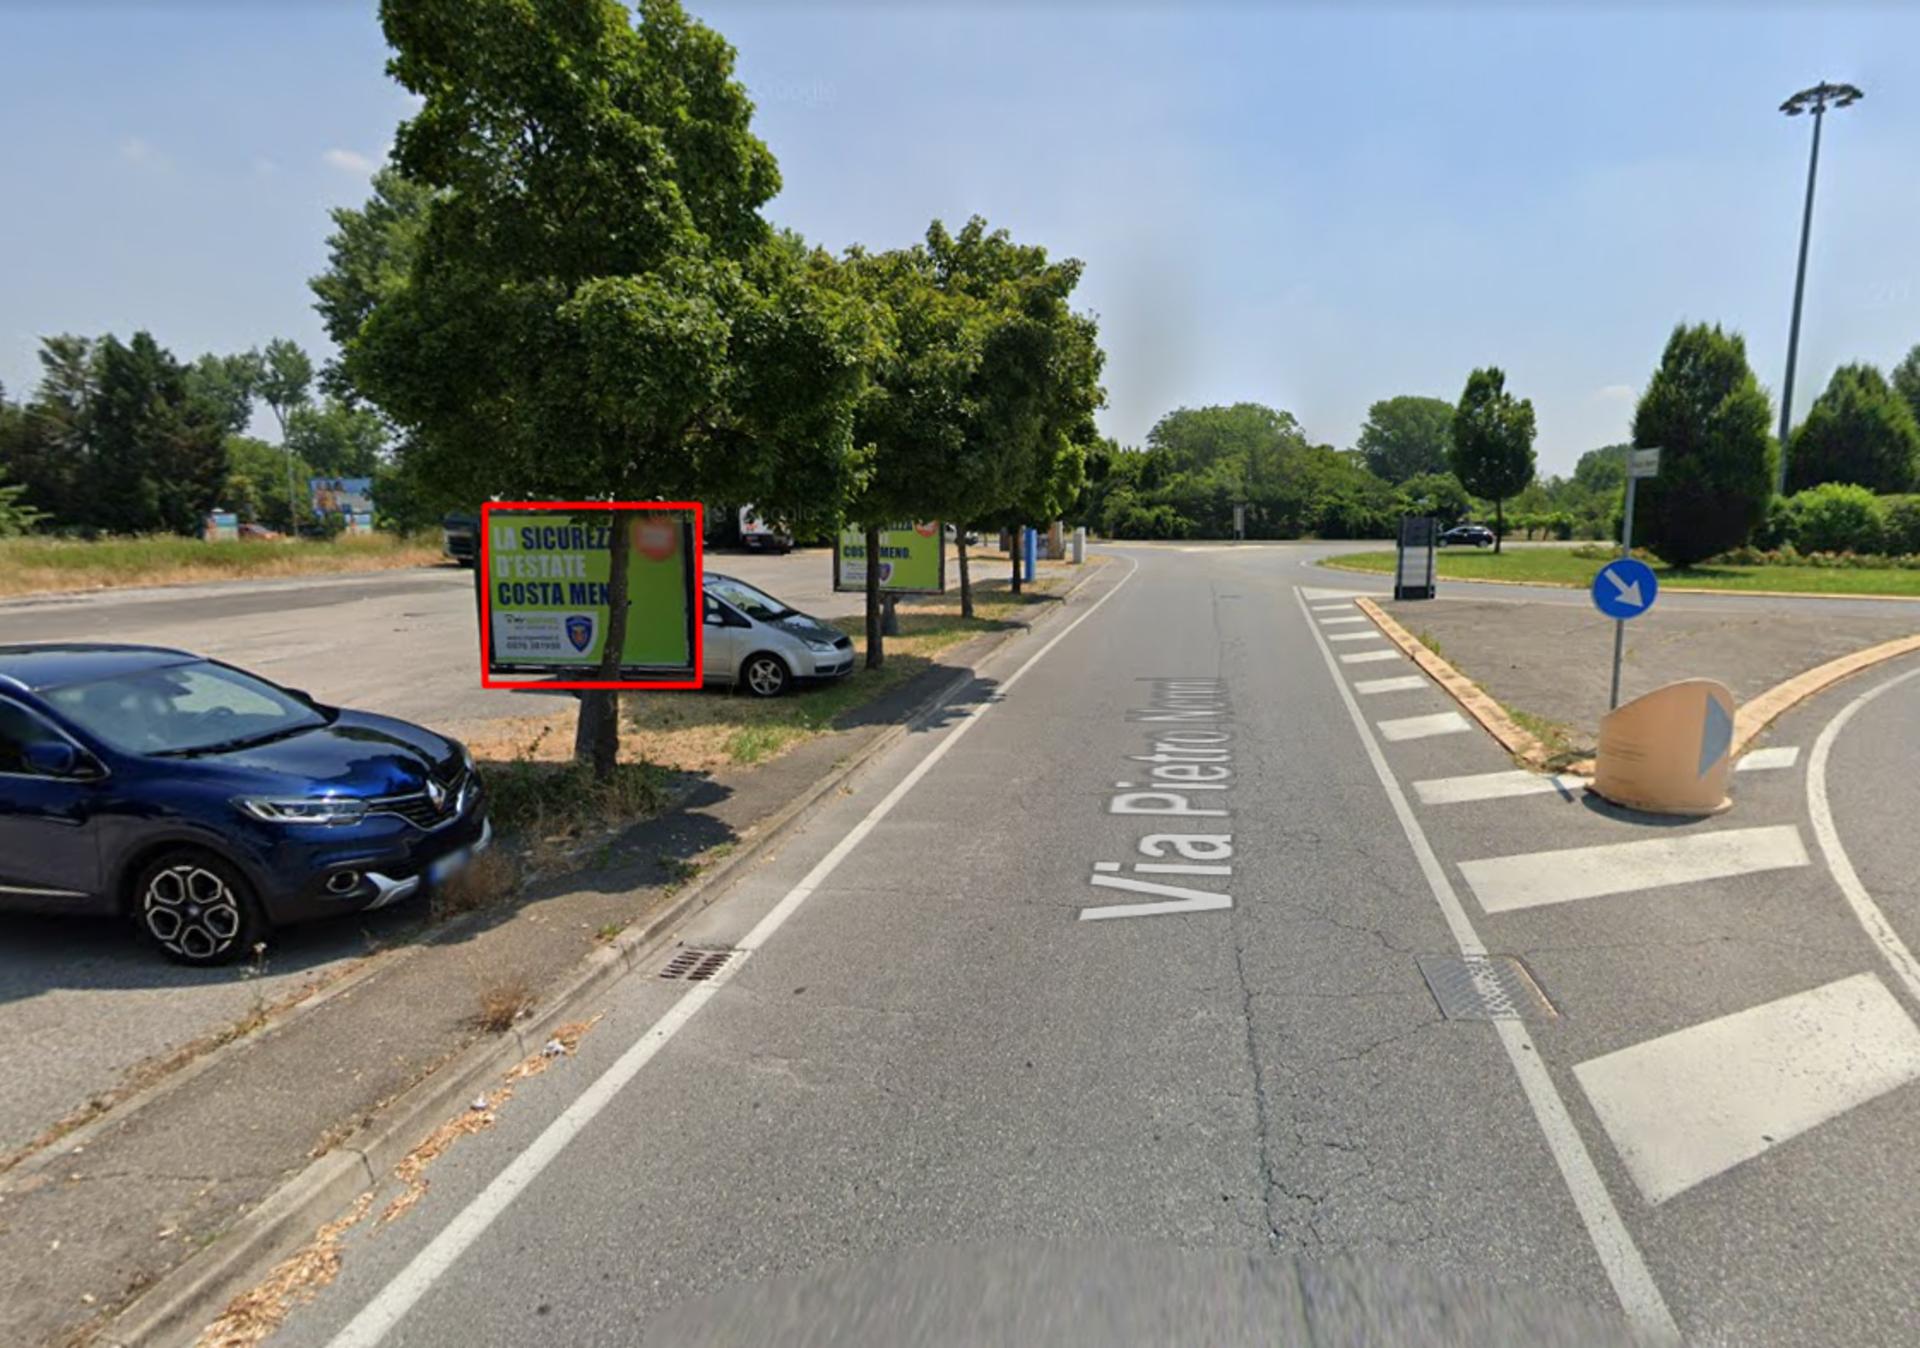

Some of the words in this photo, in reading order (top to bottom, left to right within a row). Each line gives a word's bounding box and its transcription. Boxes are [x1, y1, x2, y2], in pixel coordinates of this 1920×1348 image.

[493, 527, 517, 550] LA
[521, 526, 612, 550] SICUREZ
[843, 546, 866, 558] COS
[496, 554, 587, 578] D'ESTATE
[498, 582, 565, 606] COSTA
[569, 582, 611, 607] MEN
